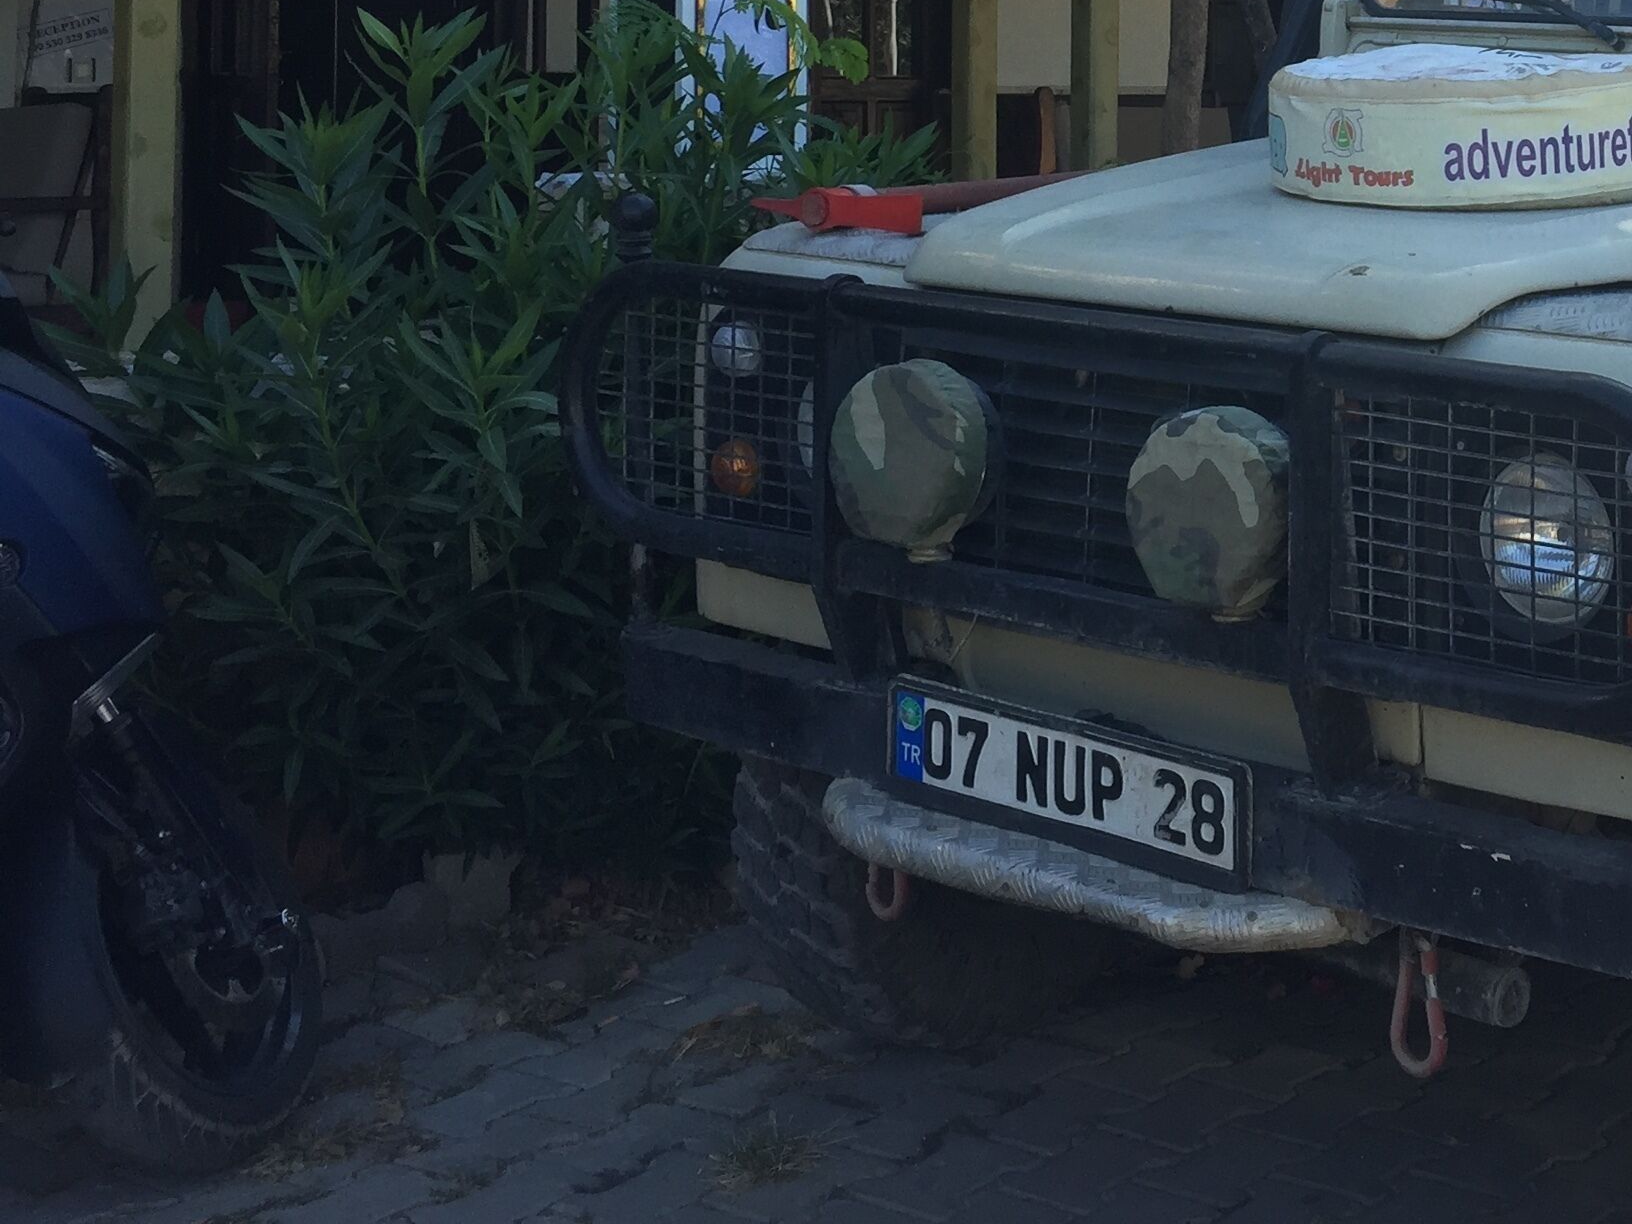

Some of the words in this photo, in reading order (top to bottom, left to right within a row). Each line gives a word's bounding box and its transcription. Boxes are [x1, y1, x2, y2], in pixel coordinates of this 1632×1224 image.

[28, 14, 101, 39] ECEPTION
[1295, 158, 1342, 188] Light
[1348, 165, 1415, 187] Tours
[901, 741, 921, 767] TR
[923, 707, 989, 789] 07
[1015, 730, 1125, 822] NUP
[1152, 768, 1225, 856] 28
